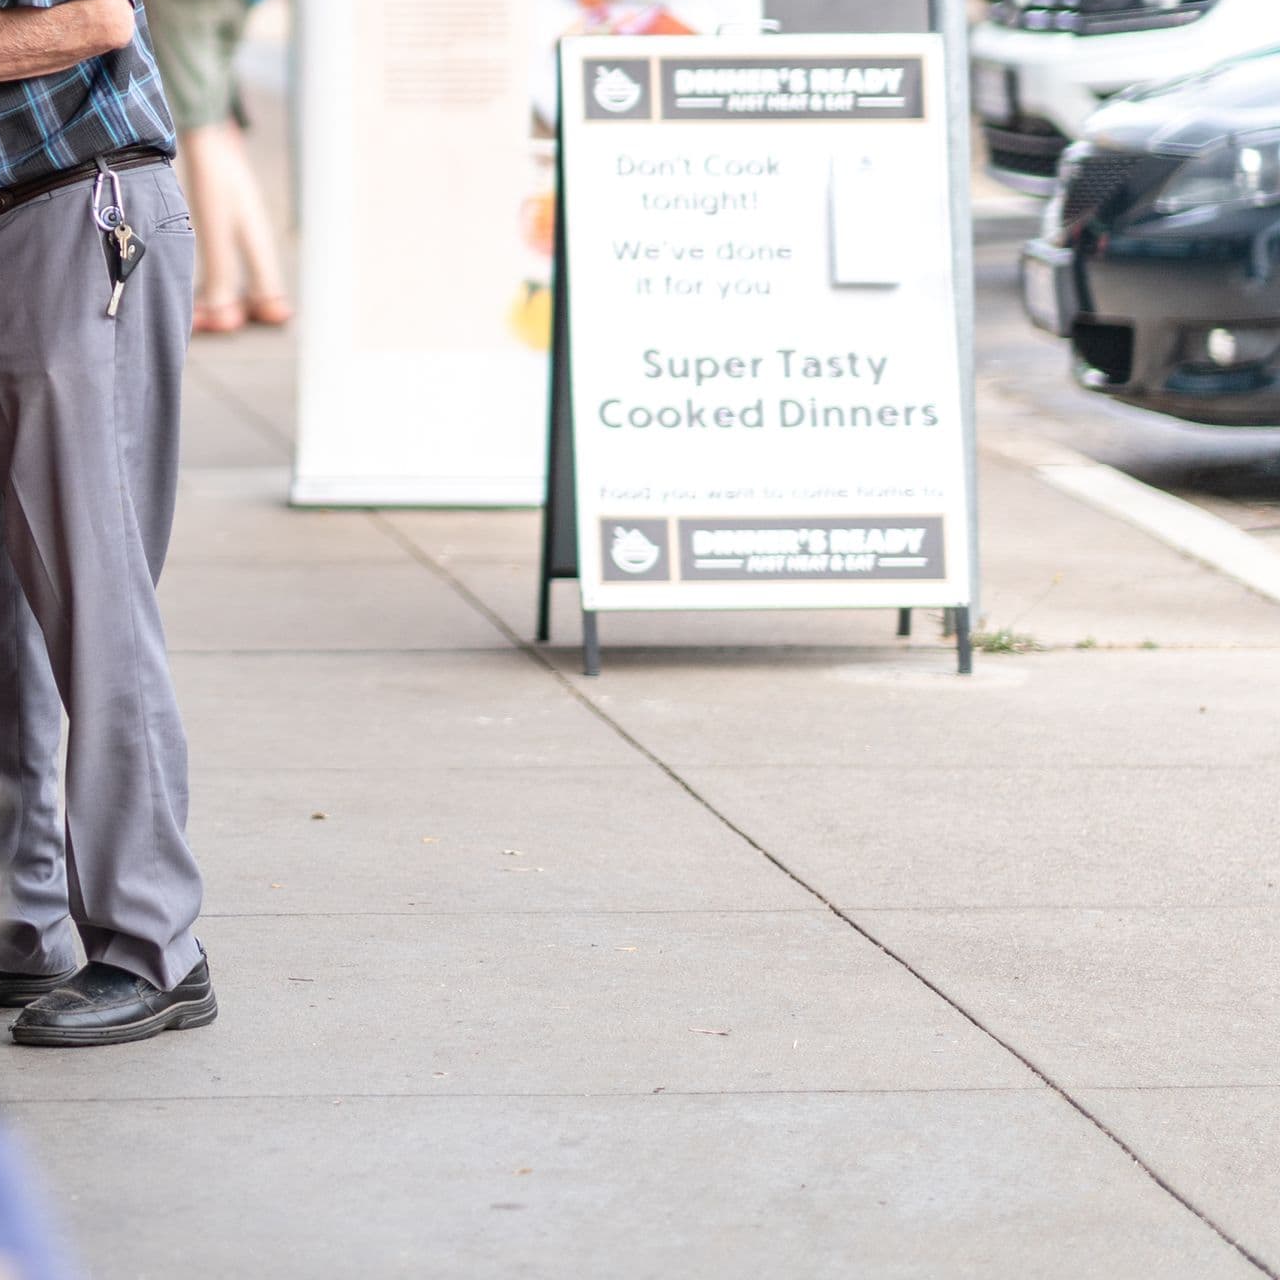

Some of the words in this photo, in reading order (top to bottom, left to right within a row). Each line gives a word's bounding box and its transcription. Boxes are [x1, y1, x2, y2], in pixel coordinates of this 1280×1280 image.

[674, 67, 807, 95] DINNER'S
[809, 67, 905, 95] READY
[616, 153, 692, 176] Don't
[703, 153, 781, 176] Cook
[641, 190, 758, 216] tonight!
[612, 239, 705, 261] We've
[715, 239, 793, 261] done
[635, 274, 652, 296] it
[663, 274, 705, 296] for
[718, 278, 771, 300] you
[642, 349, 763, 385] Super
[776, 349, 888, 385] Tasty
[598, 398, 765, 429] Cooked
[779, 397, 939, 428] Dinners
[692, 528, 828, 555] DINNER'S
[830, 527, 926, 554] READY
